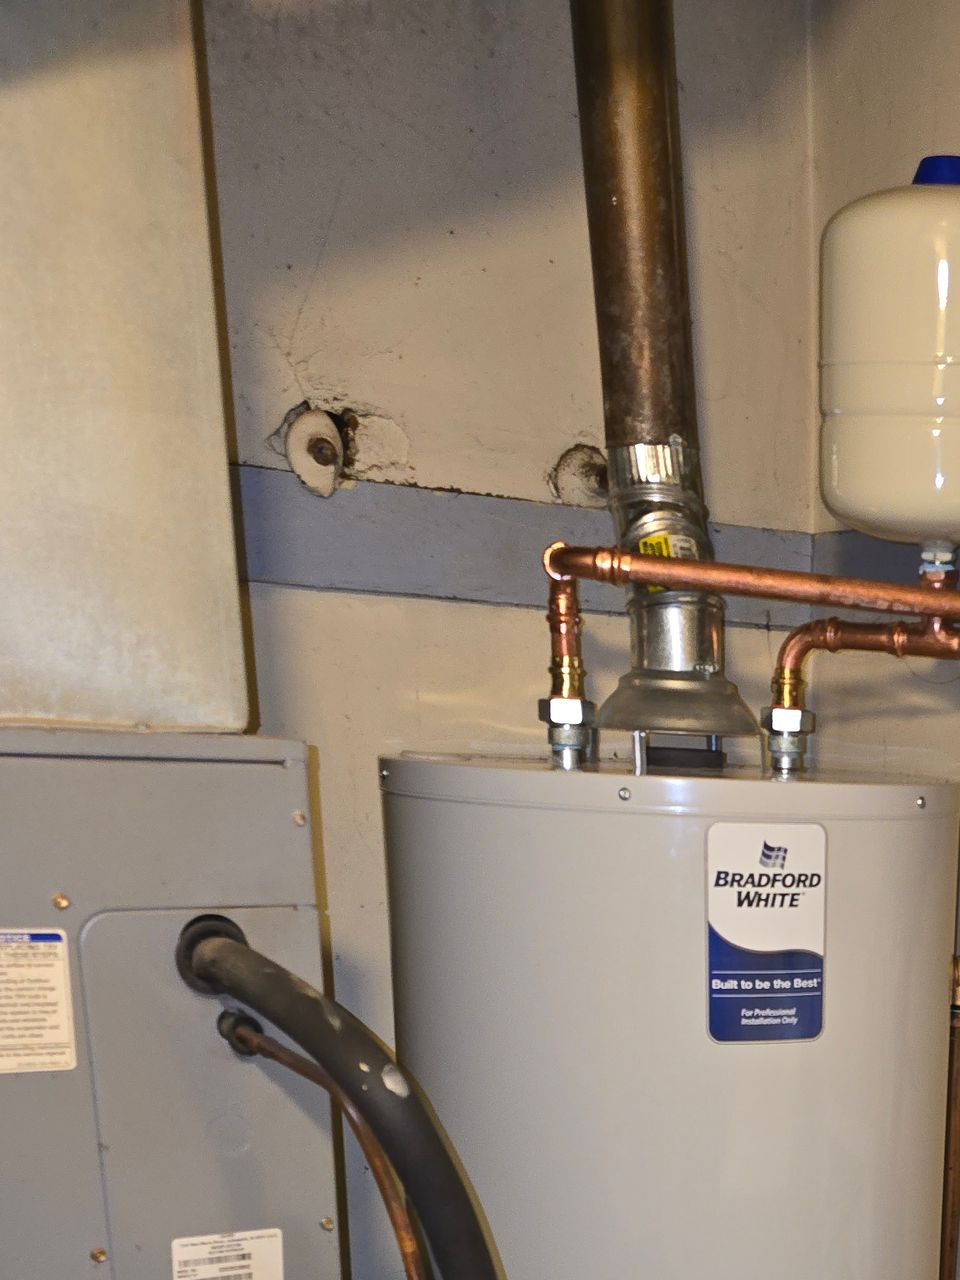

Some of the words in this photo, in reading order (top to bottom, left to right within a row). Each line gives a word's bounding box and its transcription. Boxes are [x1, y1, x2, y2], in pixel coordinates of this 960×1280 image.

[714, 870, 821, 889] BRADFORD
[736, 891, 800, 908] WHITE
[711, 979, 738, 990] Built
[741, 979, 753, 990] to
[755, 979, 770, 990] be
[772, 979, 791, 990] the
[793, 977, 819, 989] Best
[741, 1007, 753, 1017] For
[754, 1007, 796, 1018] Professional
[741, 1016, 782, 1026] Installation
[782, 1015, 799, 1026] Only
